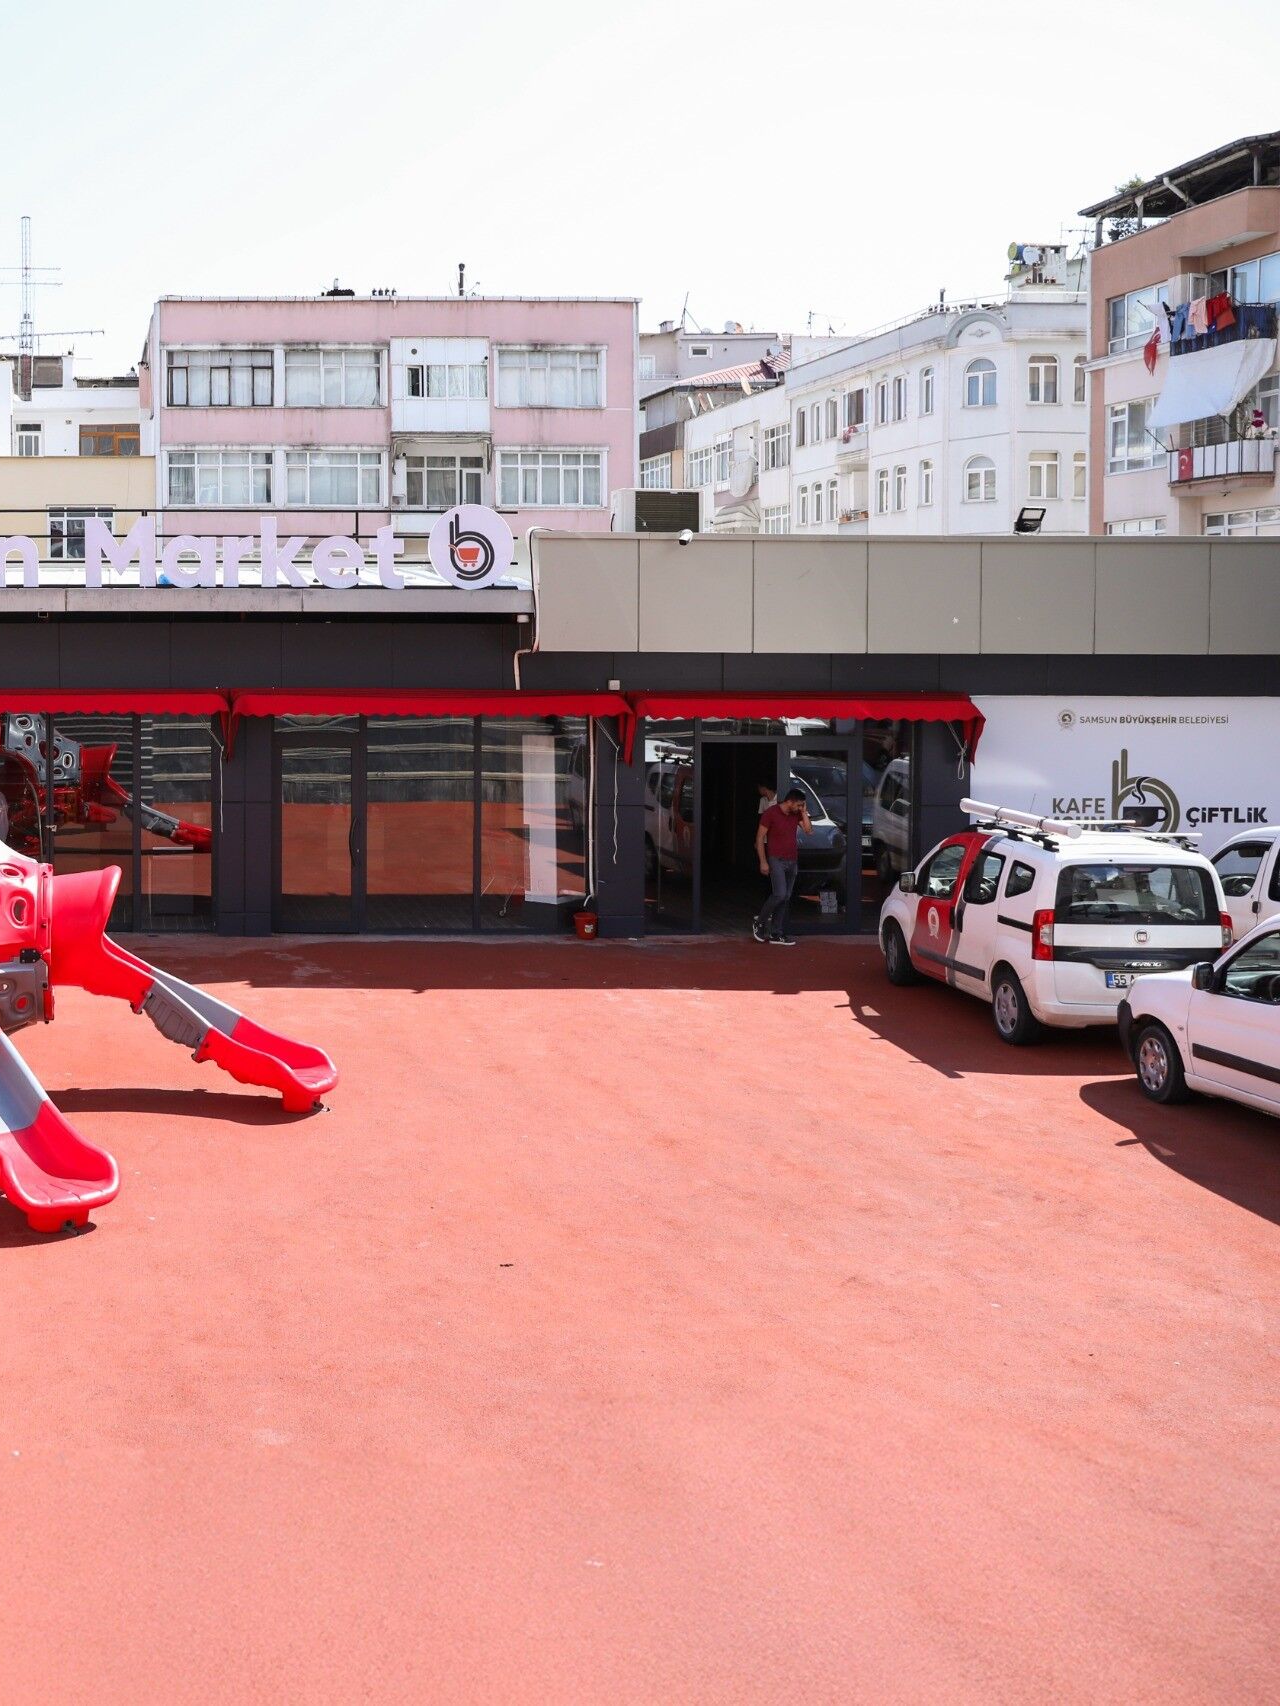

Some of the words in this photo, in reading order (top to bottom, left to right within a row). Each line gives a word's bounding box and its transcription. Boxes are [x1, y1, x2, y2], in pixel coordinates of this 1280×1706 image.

[84, 516, 405, 590] Market
[1079, 716, 1118, 724] SAMSUN
[1119, 714, 1177, 725] BÜYÜKŞEHİR
[1178, 714, 1229, 724] BELEDİYESİ
[1052, 797, 1106, 814] KAFE
[1113, 974, 1127, 986] 55
